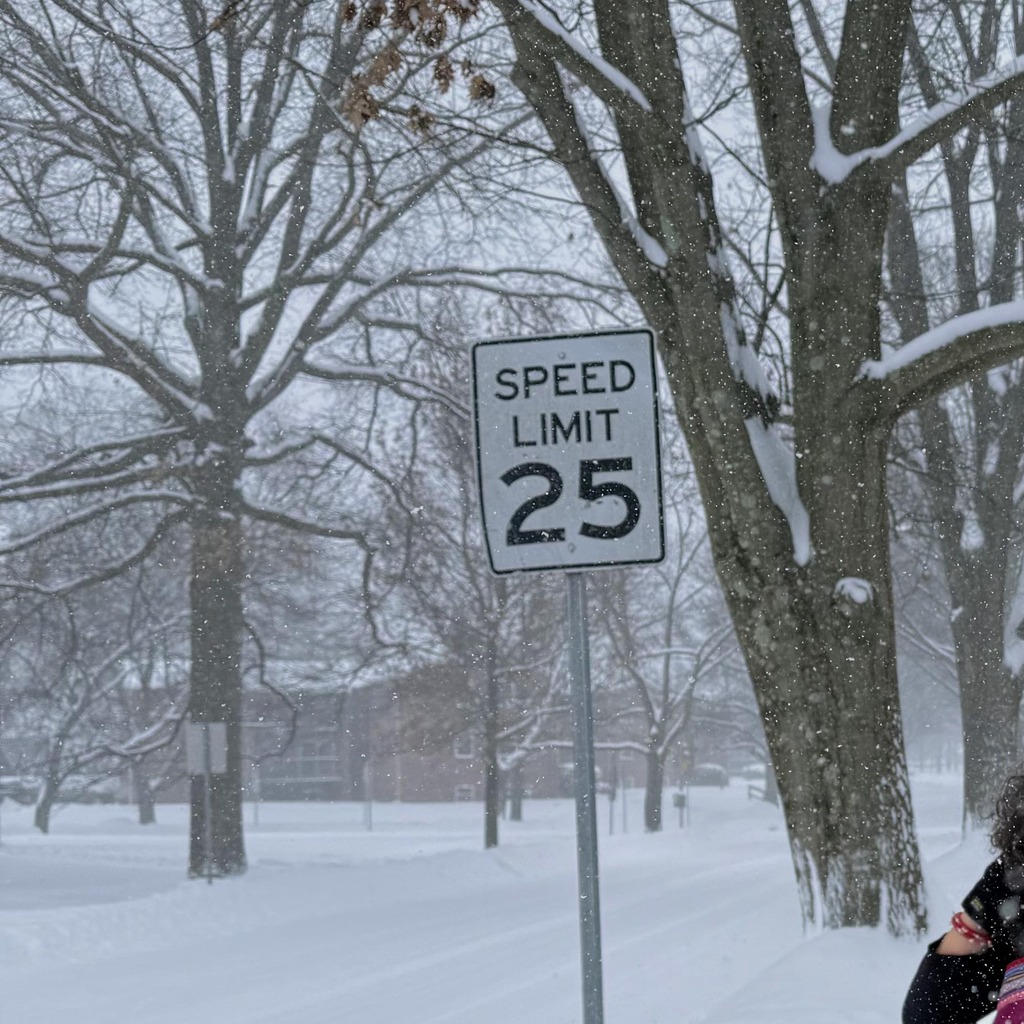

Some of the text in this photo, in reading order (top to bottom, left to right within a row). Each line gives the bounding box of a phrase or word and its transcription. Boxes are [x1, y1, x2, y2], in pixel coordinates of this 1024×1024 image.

[494, 360, 636, 401] SPEED
[512, 408, 619, 447] LIMIT
[499, 456, 641, 547] 25
